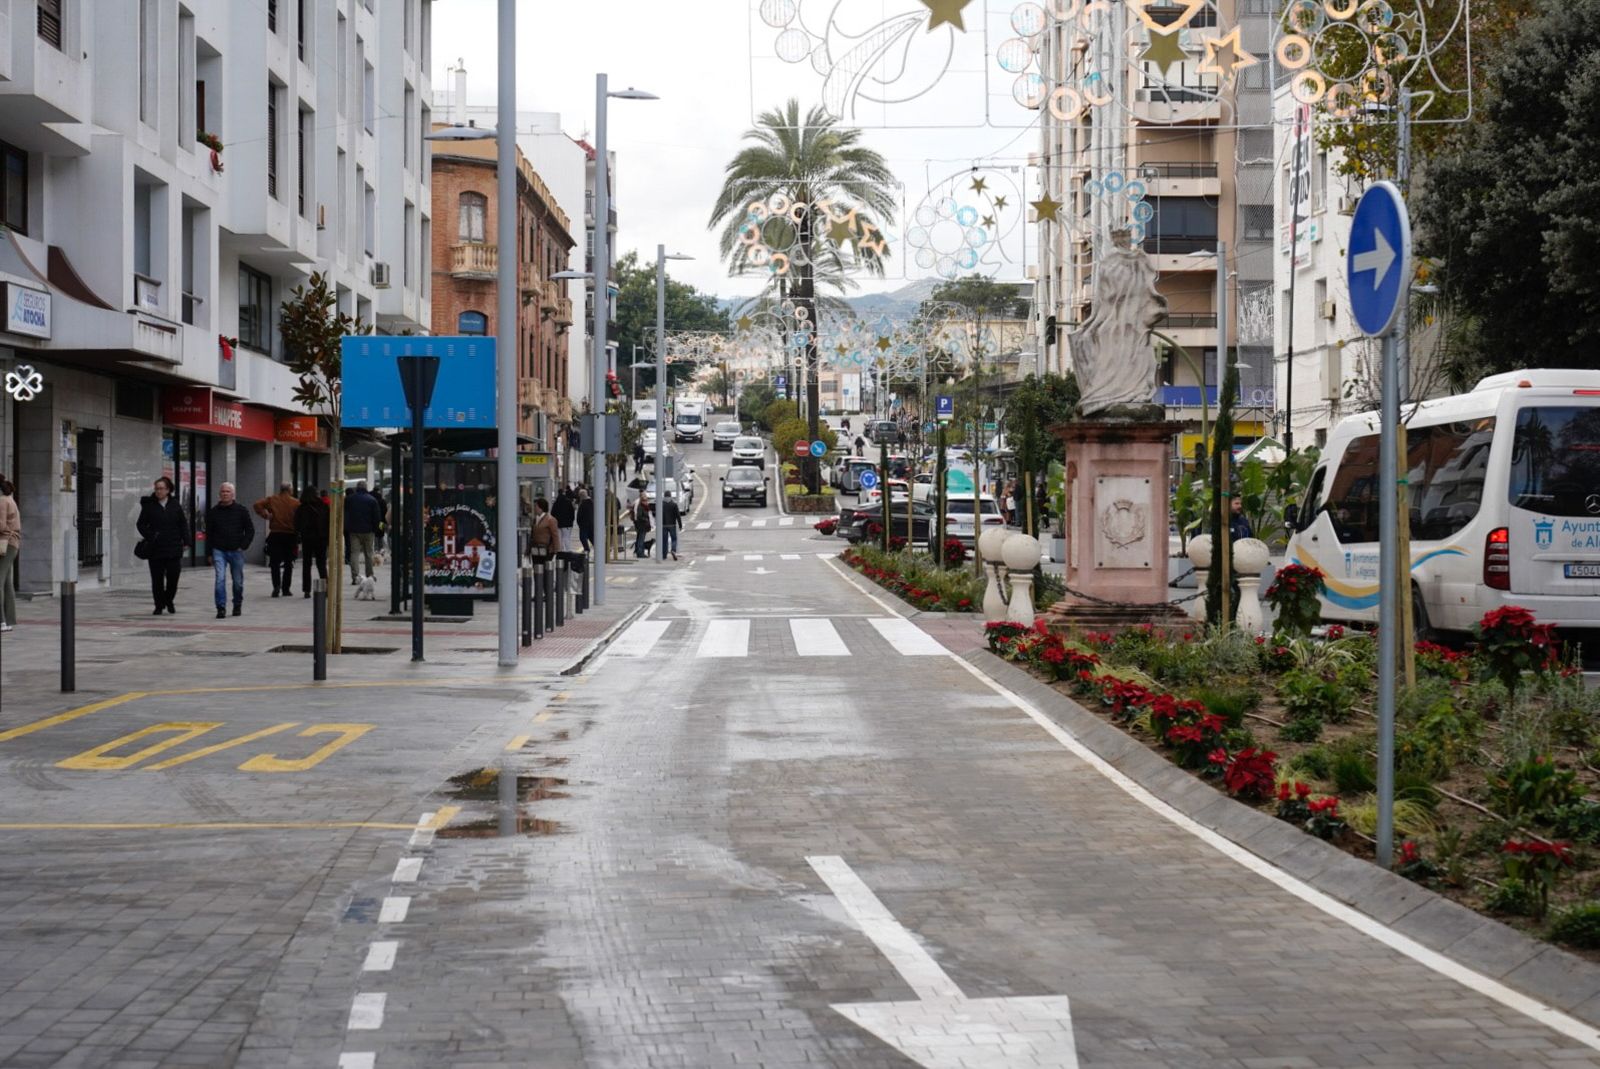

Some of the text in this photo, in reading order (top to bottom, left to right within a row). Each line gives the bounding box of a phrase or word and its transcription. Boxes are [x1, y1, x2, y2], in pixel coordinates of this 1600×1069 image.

[23, 292, 46, 312] SEGUROS
[23, 308, 46, 327] ATOCHA
[218, 406, 242, 430] MAPFRE
[1571, 535, 1600, 548] de Al
